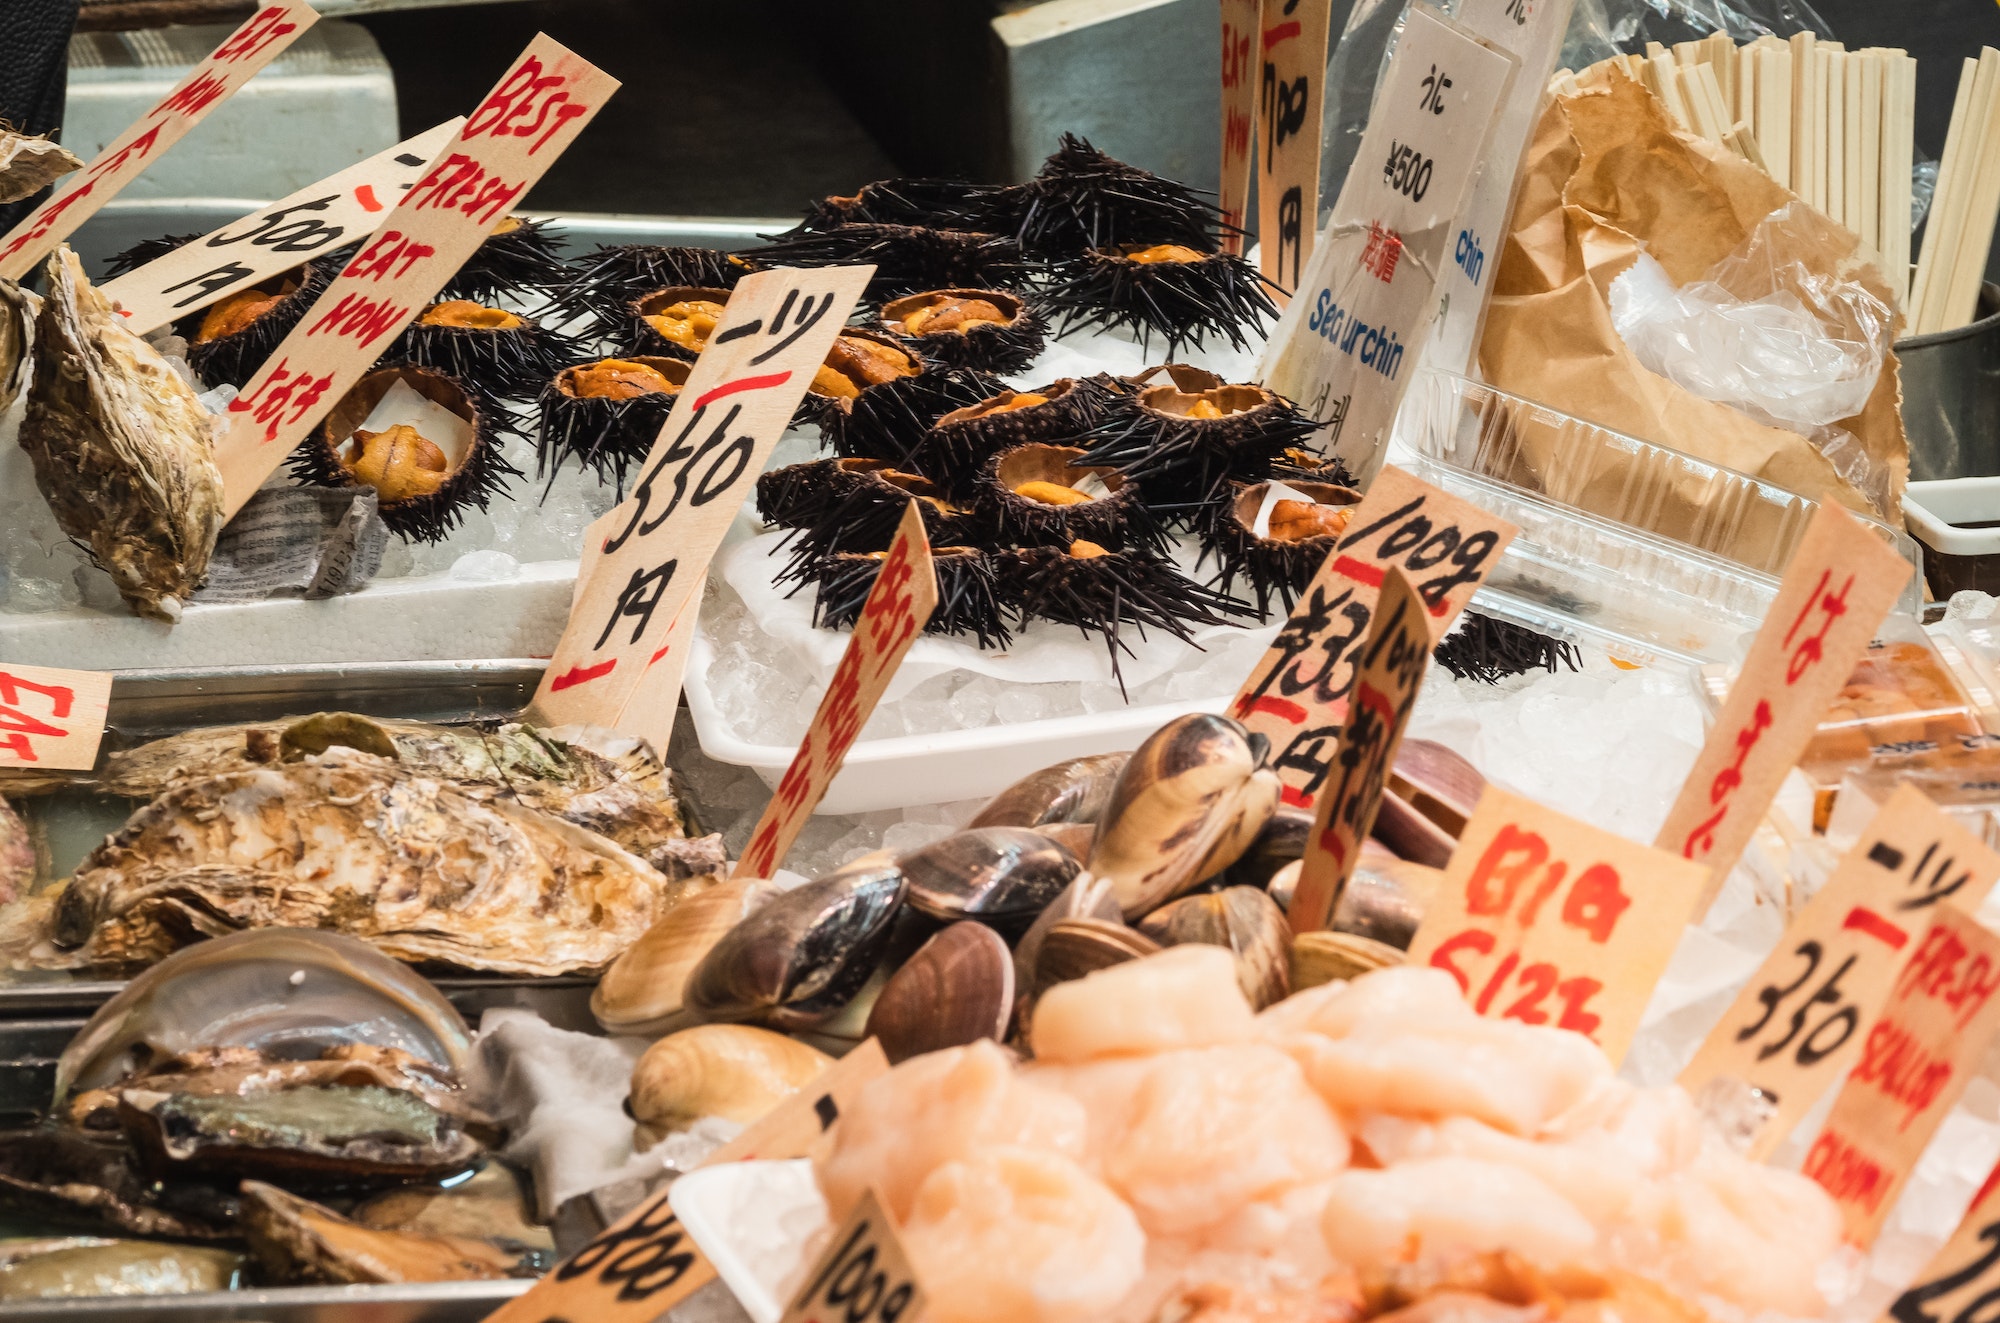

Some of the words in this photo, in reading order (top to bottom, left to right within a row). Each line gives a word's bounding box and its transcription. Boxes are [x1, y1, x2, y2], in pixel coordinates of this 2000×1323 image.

[214, 7, 296, 62] EAT
[1222, 22, 1250, 90] EAT
[149, 69, 229, 118] NOW
[461, 54, 587, 155] BEST
[1420, 63, 1453, 115] うに
[398, 153, 527, 225] FRESH
[1383, 138, 1434, 203] ¥500
[206, 194, 344, 251] 500
[342, 230, 435, 281] EAT
[1278, 184, 1302, 292] 円
[161, 261, 255, 308] 円
[307, 293, 409, 349] NOW
[605, 405, 755, 554] 550
[1339, 495, 1502, 594] 100g
[594, 558, 678, 652] 円
[1466, 823, 1633, 944] BIG
[1735, 940, 1860, 1066] 350
